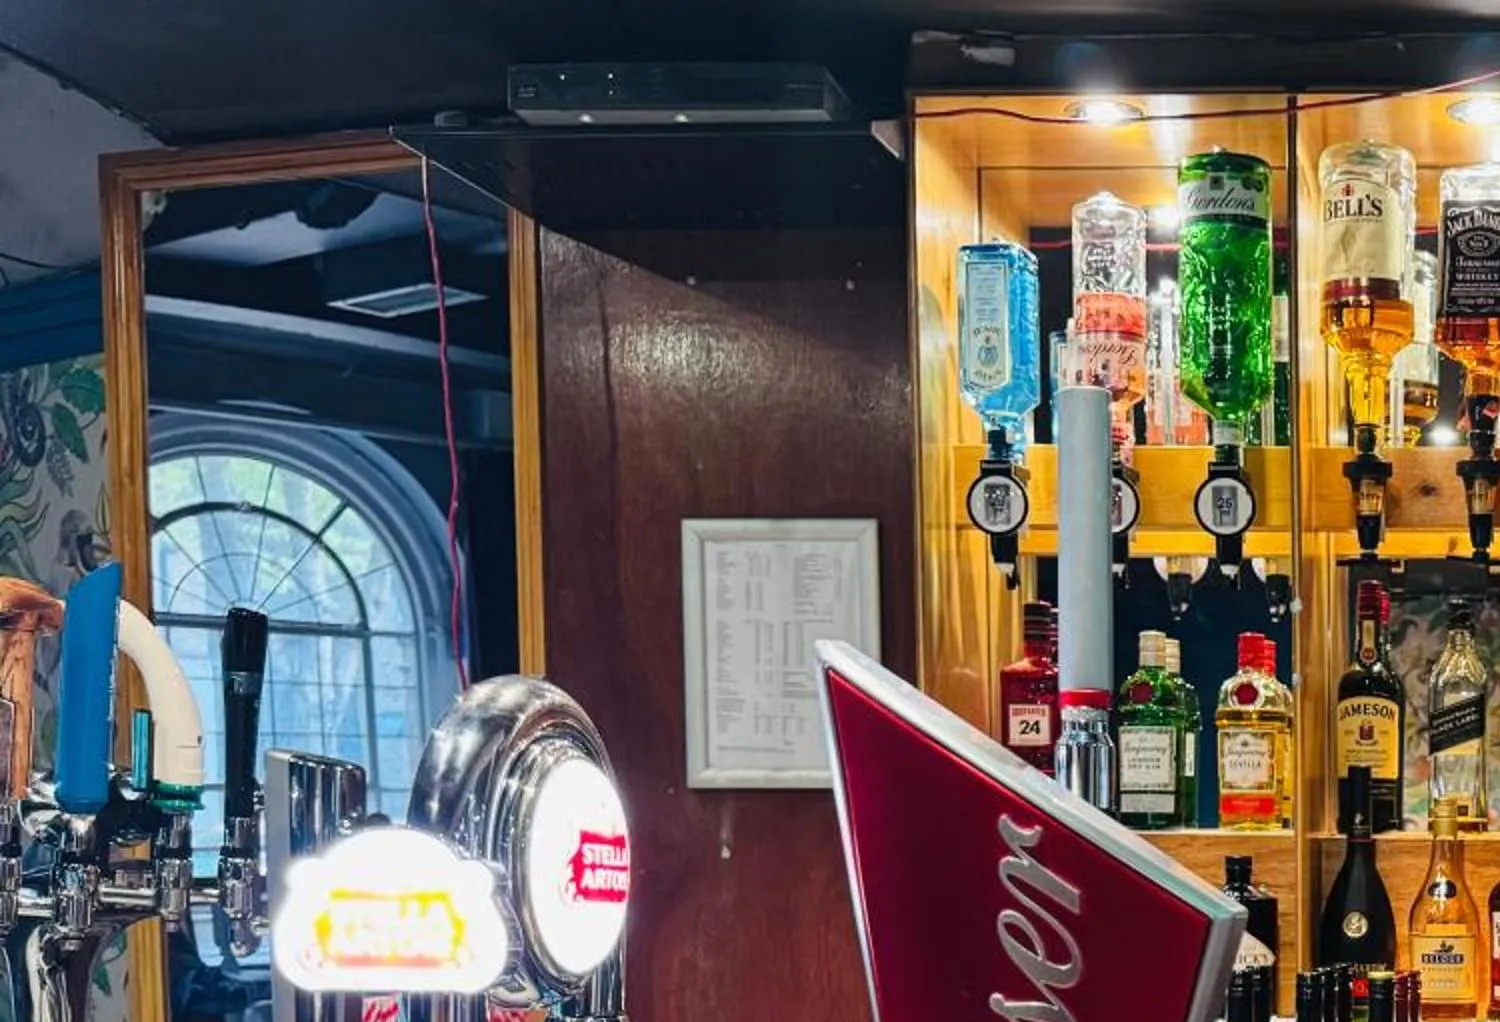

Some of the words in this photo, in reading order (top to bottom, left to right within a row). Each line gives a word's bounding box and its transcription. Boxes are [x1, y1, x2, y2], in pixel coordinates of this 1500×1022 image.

[1323, 194, 1383, 223] BELL'S
[1339, 703, 1396, 722] JAMESON
[1018, 719, 1041, 735] 24
